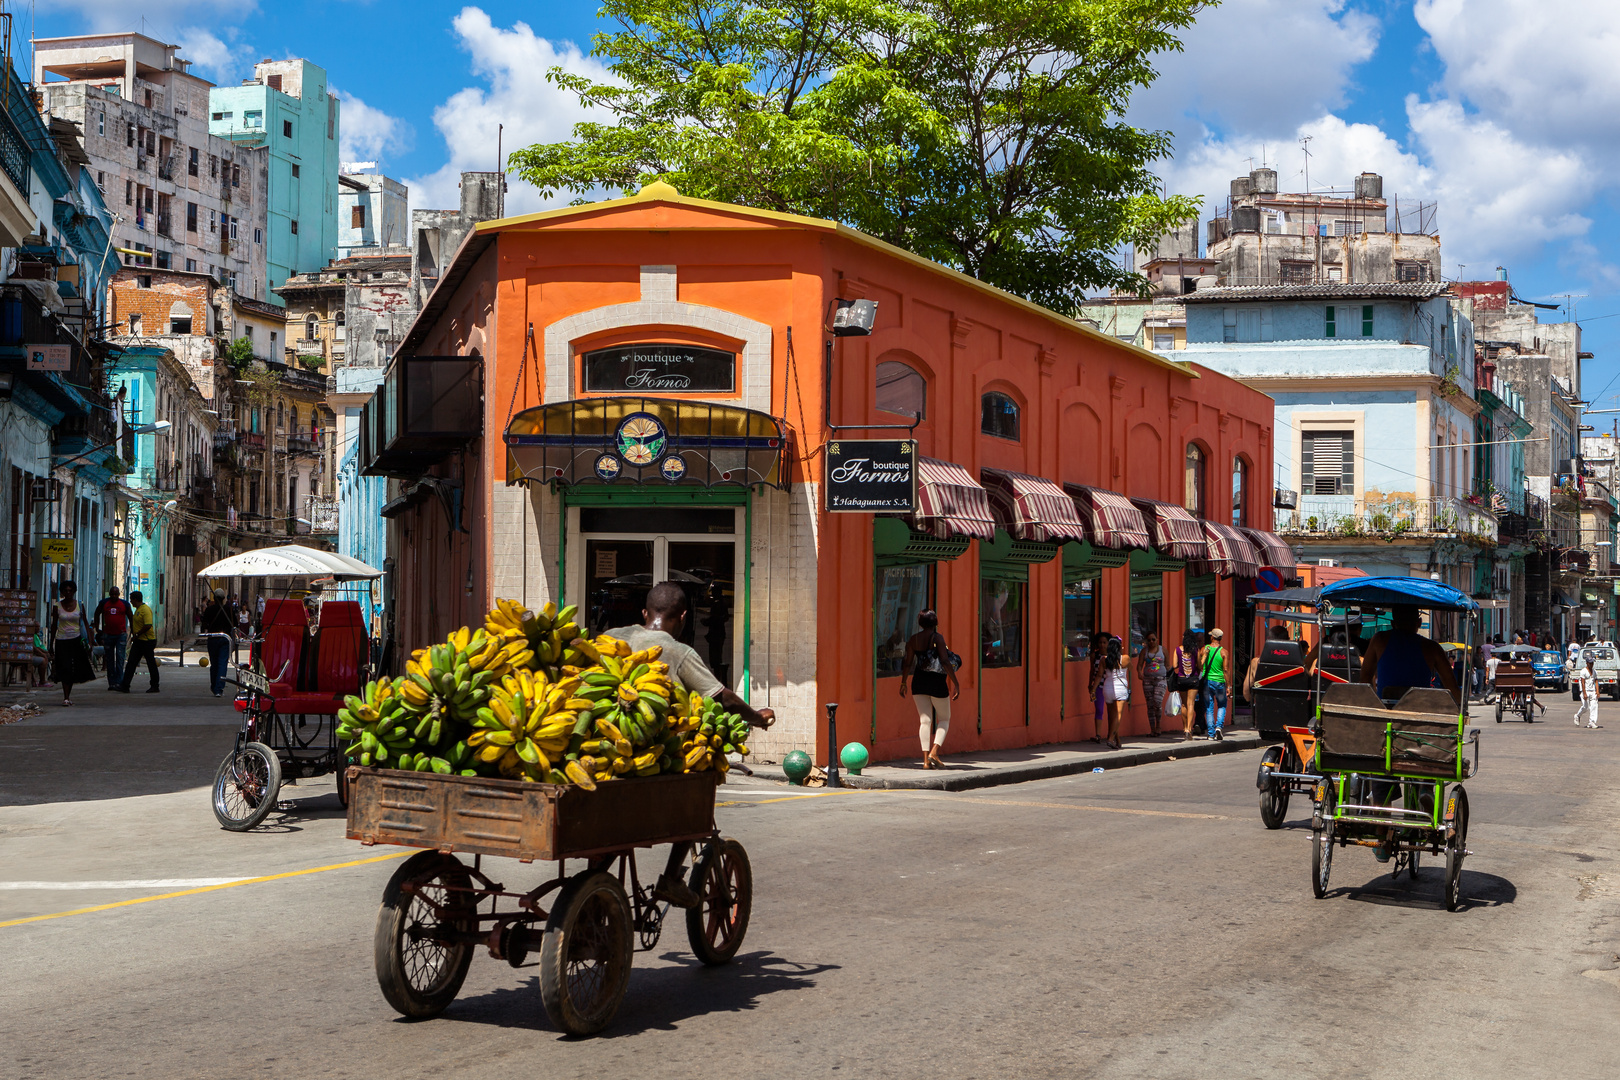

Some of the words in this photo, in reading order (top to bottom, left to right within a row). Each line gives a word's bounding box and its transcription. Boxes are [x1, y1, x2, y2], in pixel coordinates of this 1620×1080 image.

[633, 351, 681, 365] boutique
[625, 368, 691, 388] Fornos
[831, 458, 910, 483] Fornos
[872, 461, 910, 471] boutique
[839, 497, 892, 508] Habaguanex
[893, 498, 910, 506] S.A.
[884, 568, 905, 577] PACIFIC
[906, 566, 922, 577] TRAIL
[244, 671, 263, 687] TAXI
